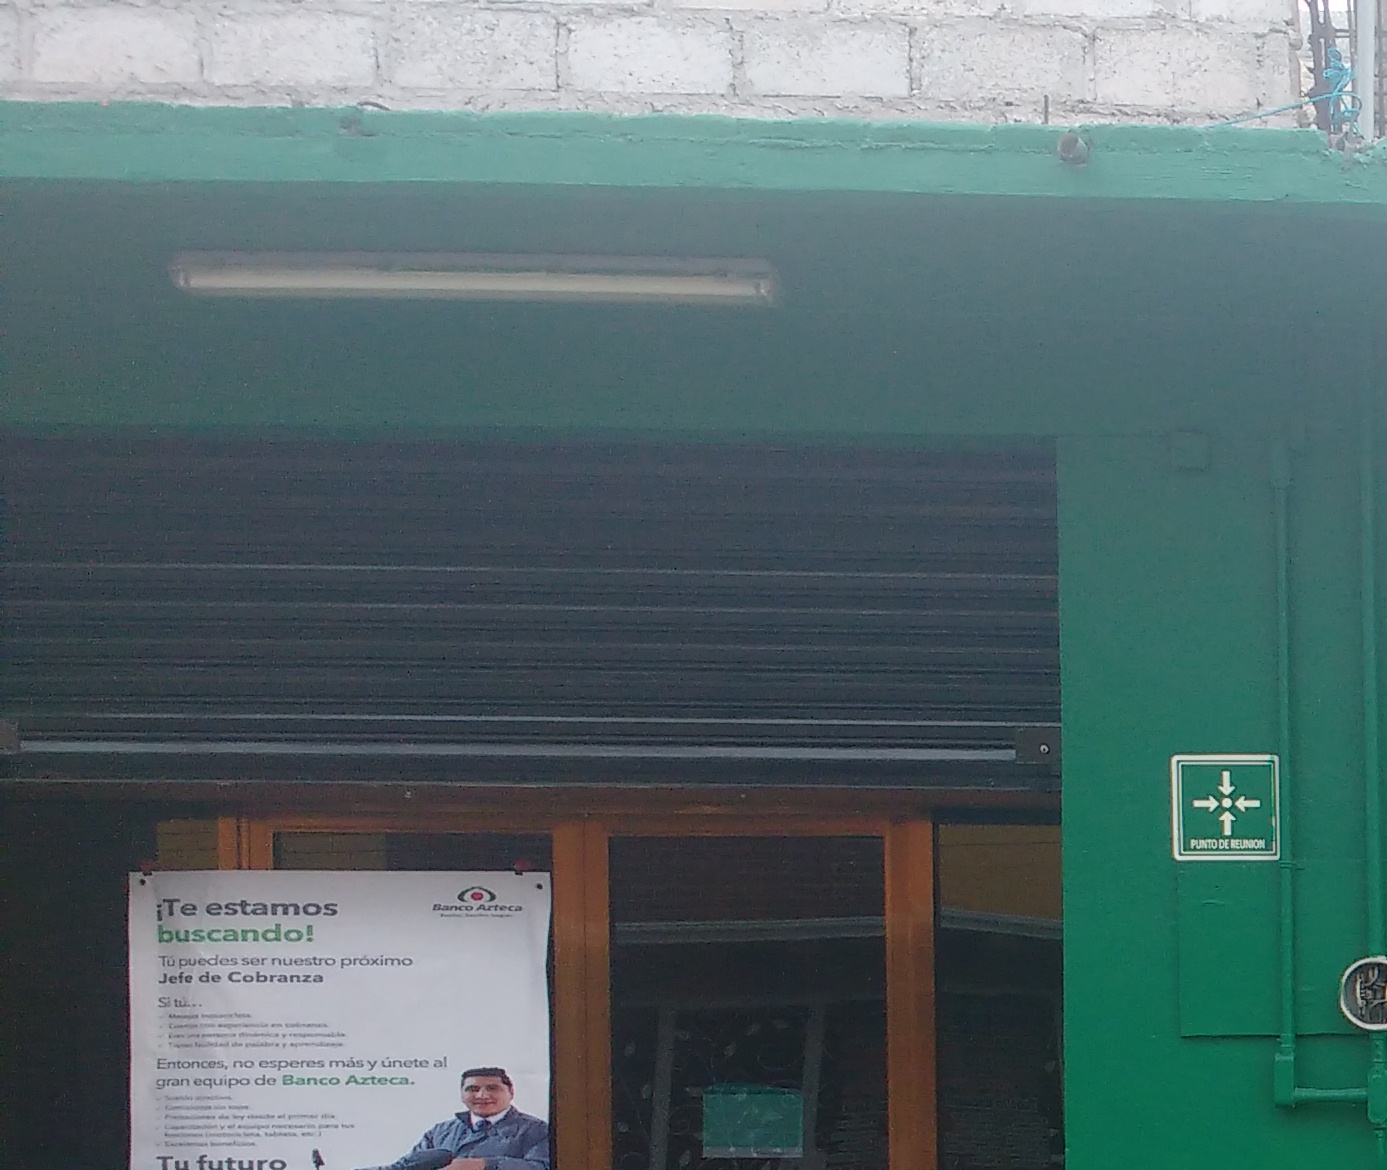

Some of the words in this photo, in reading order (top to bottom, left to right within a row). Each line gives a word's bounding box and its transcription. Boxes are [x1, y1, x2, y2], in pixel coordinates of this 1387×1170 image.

[1190, 838, 1218, 850] PUNTO
[1218, 838, 1230, 850] DE
[205, 900, 339, 917] estamos
[432, 903, 474, 912] Banco
[476, 903, 523, 912] Azteca
[157, 923, 315, 943] buscando!
[158, 955, 176, 967] Tú
[178, 955, 238, 969] puedes
[241, 956, 267, 967] ser
[271, 956, 337, 967] nuestro
[340, 955, 413, 969] próximo
[158, 972, 194, 984] Jefe
[198, 971, 222, 983] de
[227, 971, 324, 984] Cobranza
[156, 1058, 230, 1072] Entonces,
[232, 1060, 255, 1070] no
[258, 1059, 325, 1072] esperes
[328, 1057, 365, 1070] más
[366, 1059, 378, 1072] y
[381, 1056, 430, 1069] únete
[433, 1056, 448, 1069] al
[155, 1077, 190, 1090] gran
[193, 1075, 250, 1089] equipo
[254, 1074, 277, 1087] de
[281, 1075, 341, 1087] Banco
[345, 1075, 416, 1087] Azteca.
